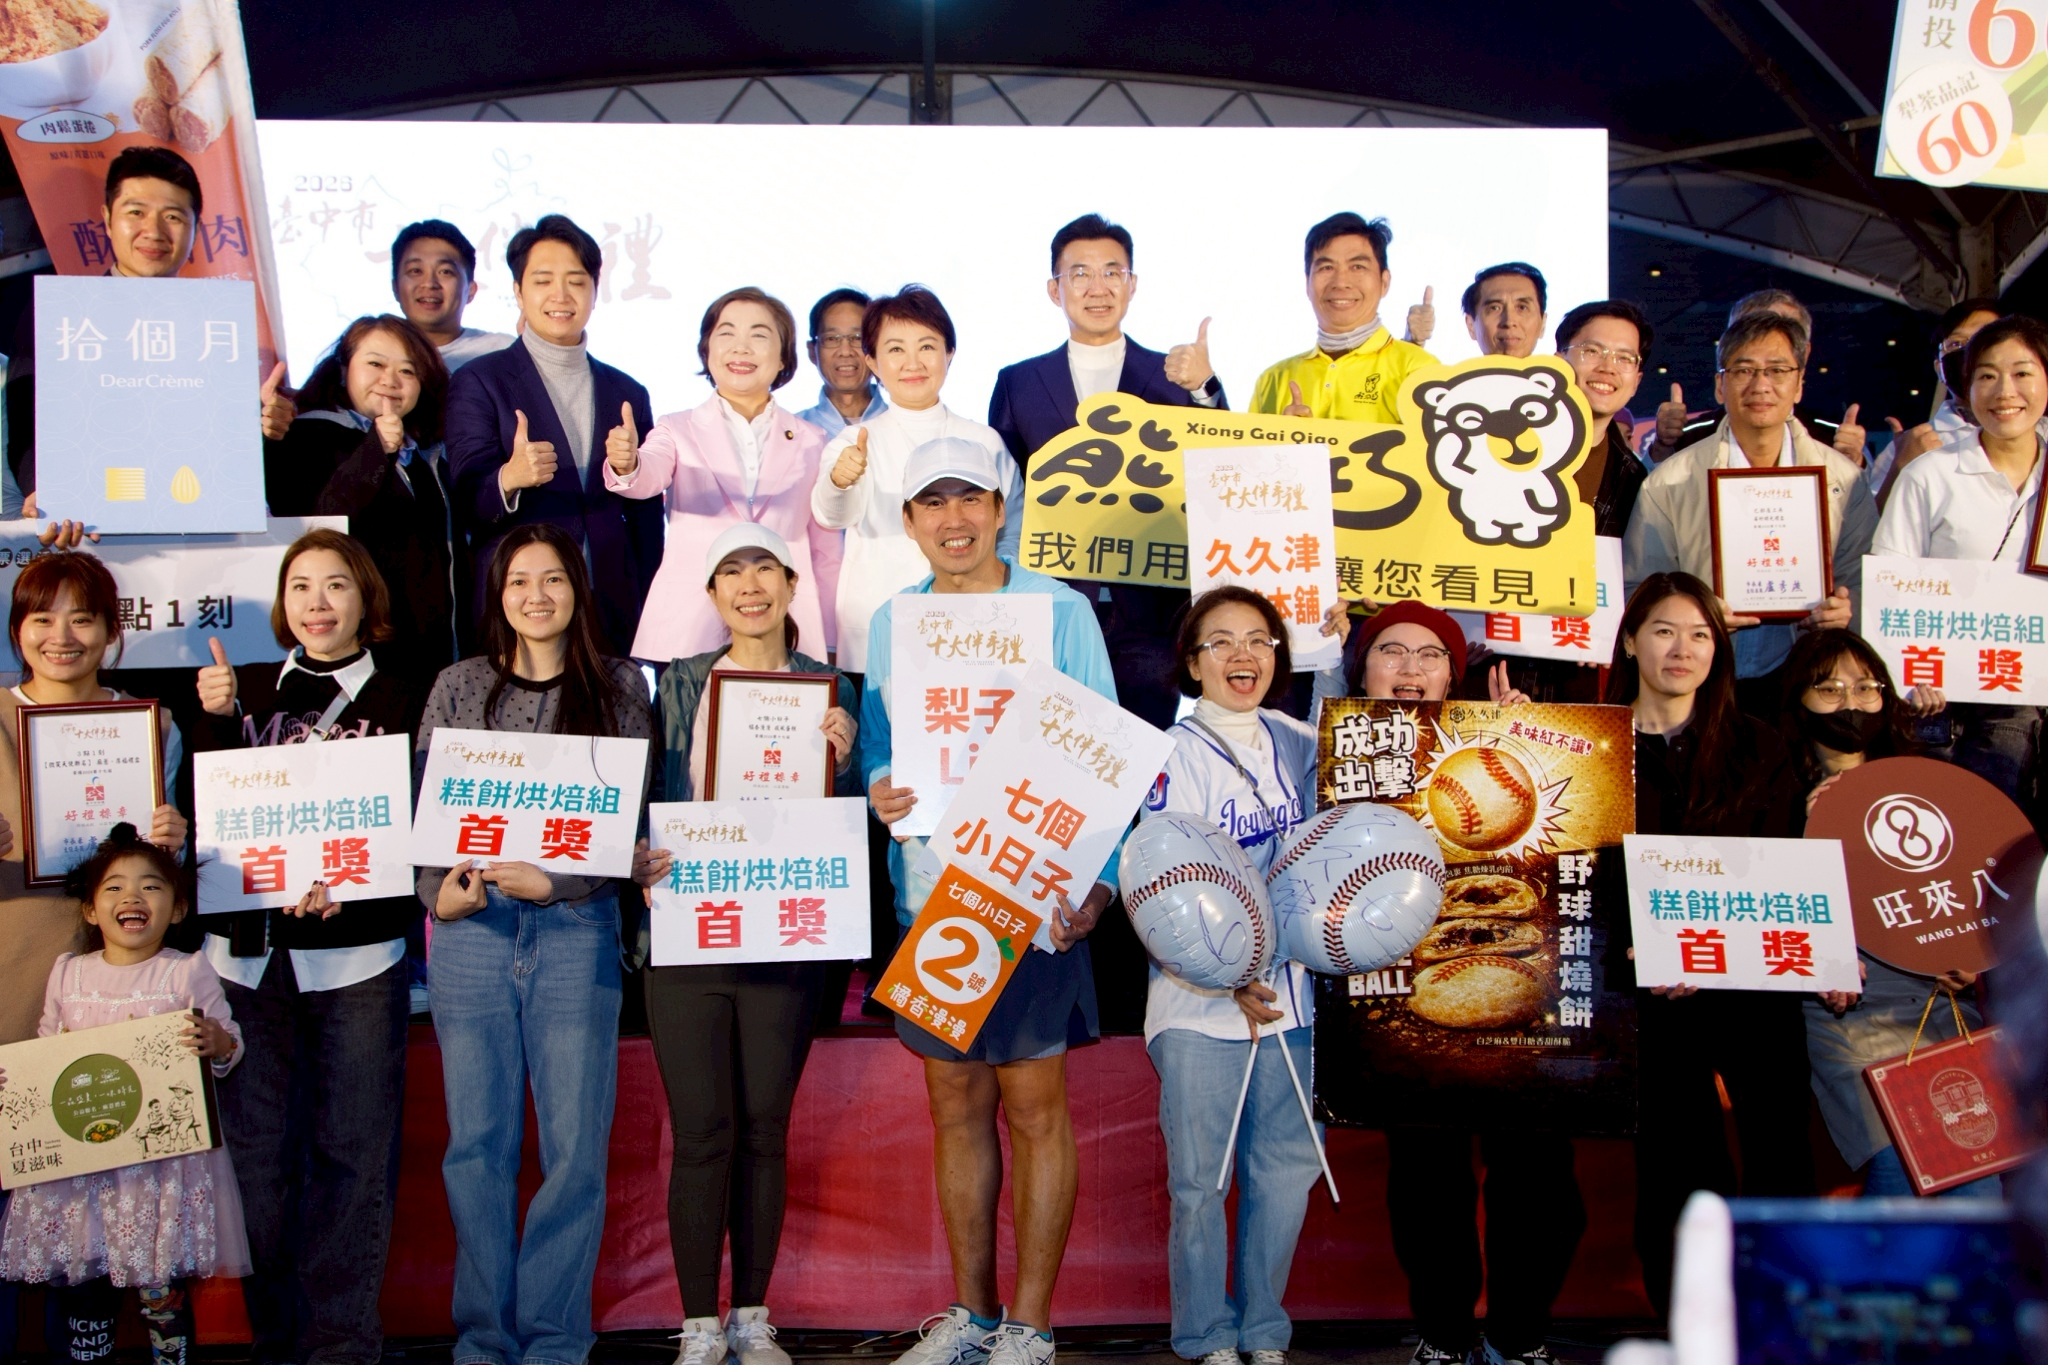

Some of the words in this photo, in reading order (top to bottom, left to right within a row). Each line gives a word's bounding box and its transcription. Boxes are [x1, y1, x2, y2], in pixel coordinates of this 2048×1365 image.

[1968, 0, 2037, 69] 6
[1917, 101, 1998, 175] 60
[294, 175, 353, 192] 2026
[56, 316, 239, 363] 拾個月
[1186, 422, 1245, 440] Xiong
[1250, 427, 1284, 442] Gai
[1218, 480, 1309, 512] 十大伴手禮
[1205, 533, 1321, 579] 久久津
[1893, 579, 1952, 596] 十大伴手禮
[1880, 607, 2045, 644] 糕餅烘焙組
[926, 630, 1026, 665] 十大伴手禮
[1901, 645, 2023, 692] 首獎
[242, 711, 385, 747] Mad
[1332, 712, 1415, 759] 成功
[462, 750, 525, 767] 十大伴手禮
[1040, 718, 1128, 788] 十大伴手禮
[228, 768, 291, 789] 十大伴手禮
[439, 776, 621, 814] 糕餅烘焙組
[743, 770, 799, 783] 好禮標章
[1333, 756, 1415, 801] 出擊
[64, 806, 127, 821] 好禮標章
[214, 795, 392, 842] 糕餅烘焙組
[1004, 778, 1087, 851] 七個
[456, 813, 593, 861] 首獎
[683, 824, 748, 843] 十大伴手禮
[239, 837, 371, 894] 首獎
[669, 856, 849, 894] 糕餅烘焙組
[953, 817, 1073, 901] 小日子
[1660, 857, 1725, 875] 十大伴手禮
[948, 881, 1028, 936] 七個小日子
[1649, 889, 1833, 924] 糕餅烘焙組
[1872, 869, 2010, 929] 旺來八
[695, 897, 827, 949] 首獎
[1558, 855, 1593, 1028] 野球甜燒餅
[1915, 928, 1954, 944] WANG
[1957, 921, 1979, 934] LAI
[1981, 916, 2000, 927] BA
[1677, 928, 1816, 977] 首獎
[1348, 970, 1412, 996] BALL
[888, 982, 967, 1042] 橘香漫漫
[10, 1138, 41, 1157] 台中
[11, 1152, 63, 1176] 夏滋味
[69, 1340, 115, 1361] RIEND
[72, 1333, 108, 1347] AND
